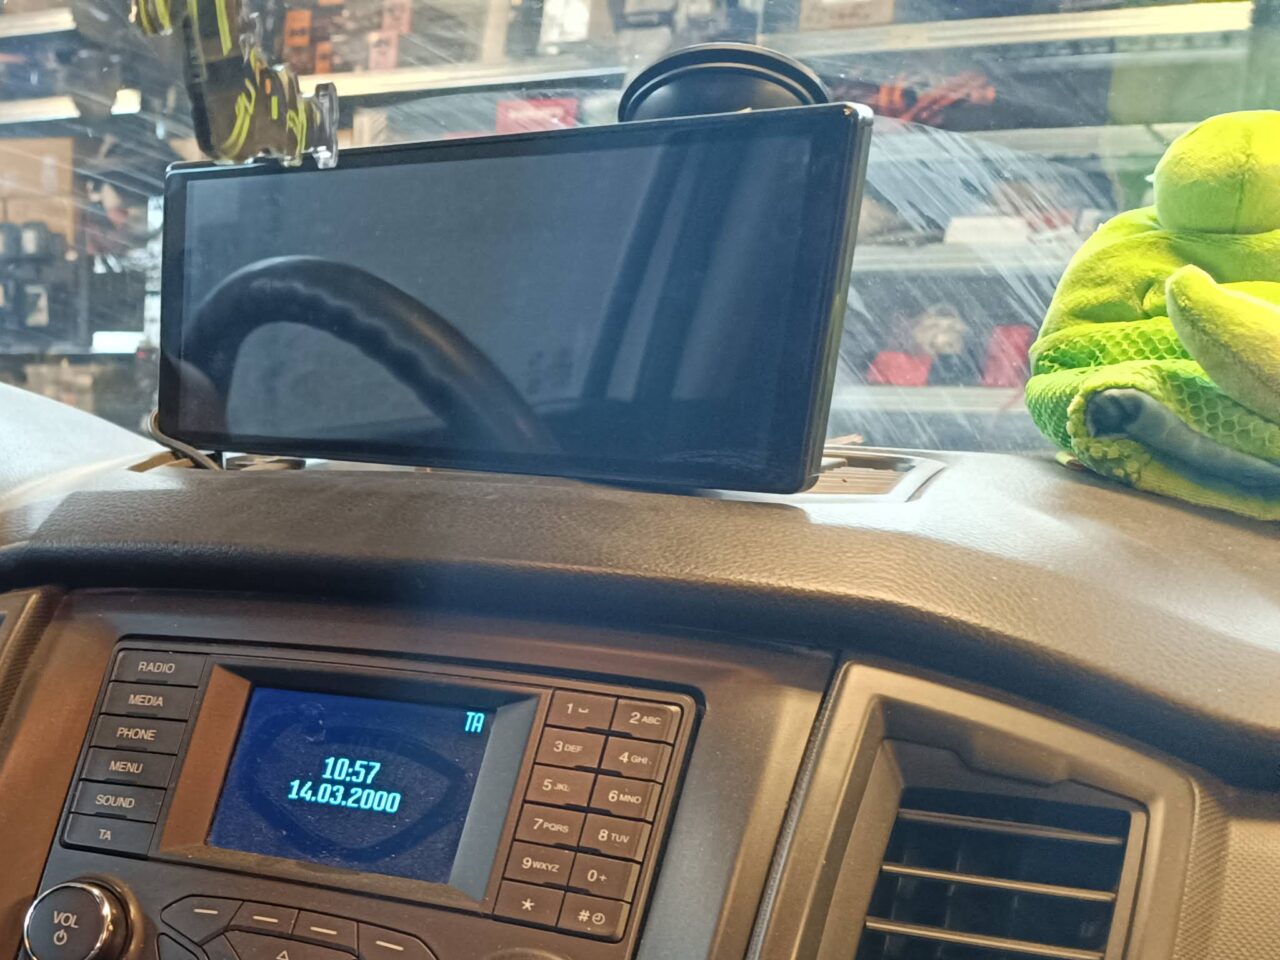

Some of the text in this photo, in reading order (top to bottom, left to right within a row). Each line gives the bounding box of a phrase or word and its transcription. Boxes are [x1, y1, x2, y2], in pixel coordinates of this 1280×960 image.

[137, 661, 176, 674] RADIO
[128, 693, 164, 707] MEDIA
[464, 711, 485, 733] TA
[116, 726, 157, 741] PHONE
[108, 760, 144, 774] MENU
[322, 756, 381, 784] 10:57
[95, 794, 136, 809] SOUND
[287, 779, 402, 814] 14.03.2000
[98, 828, 112, 841] TA
[53, 911, 79, 929] VOL
